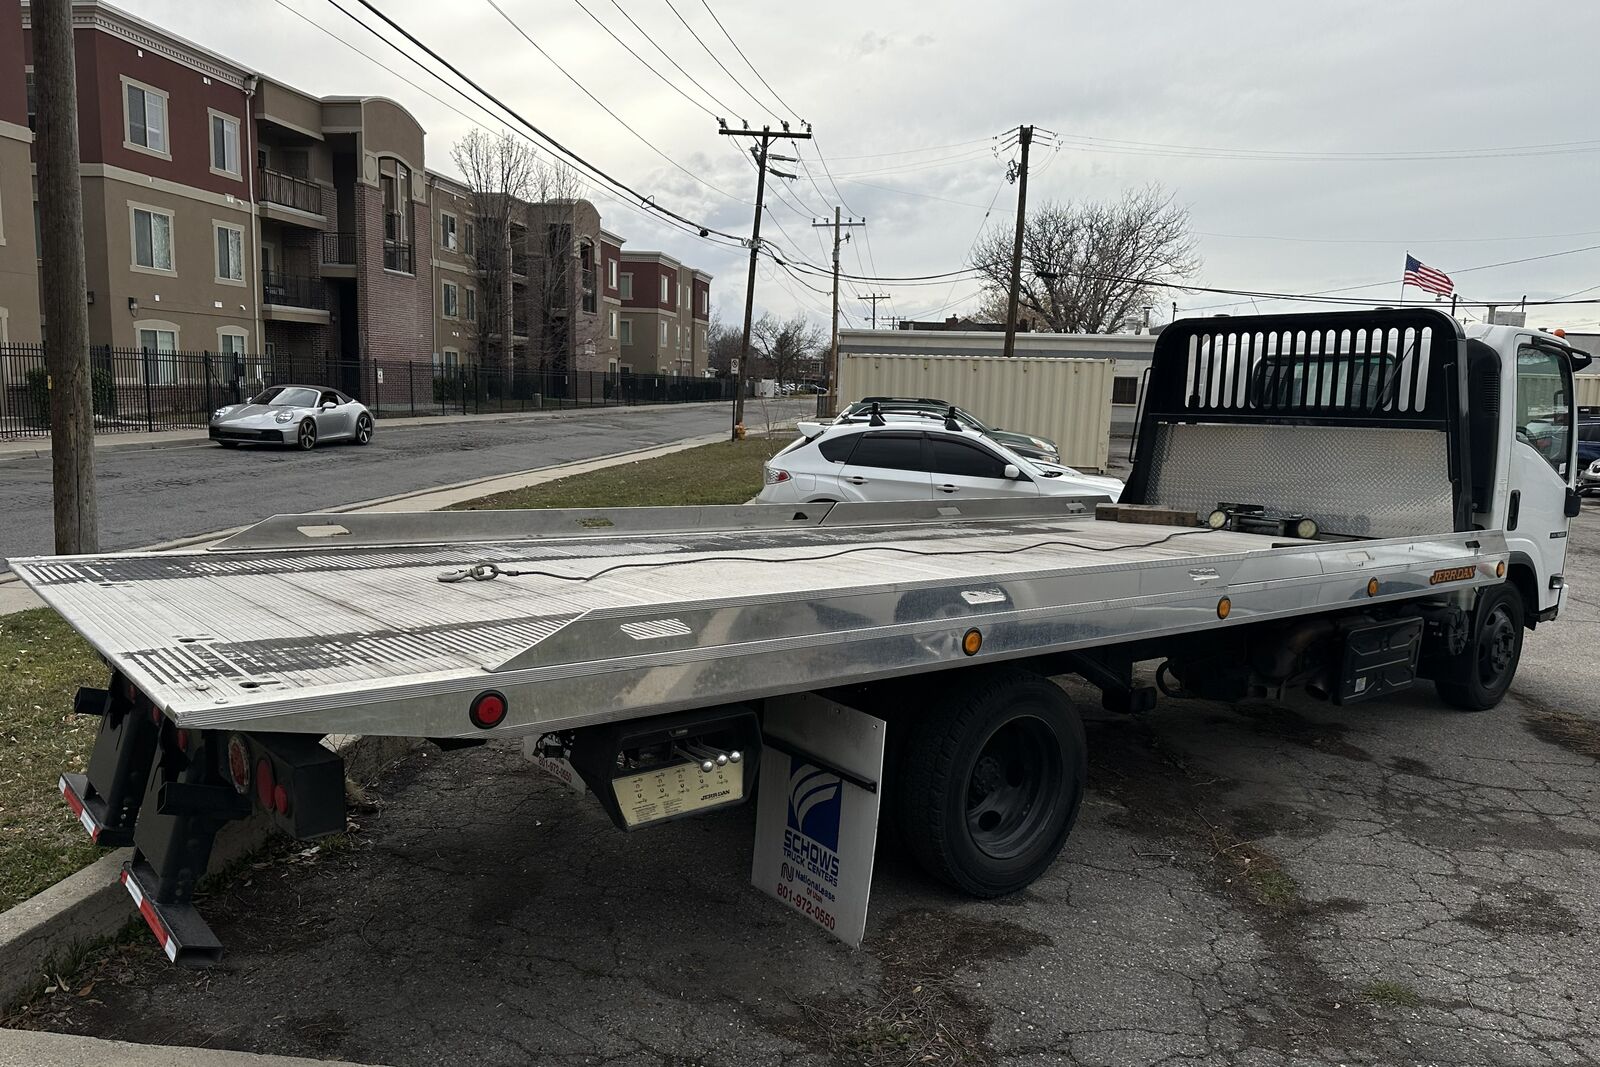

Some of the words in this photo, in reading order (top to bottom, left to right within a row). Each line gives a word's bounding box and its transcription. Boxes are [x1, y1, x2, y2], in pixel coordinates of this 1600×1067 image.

[783, 829, 840, 877] SCHOWS
[783, 847, 805, 868] TRUCK
[807, 862, 838, 887] CENTERS
[777, 883, 836, 930] 801-972-0550
